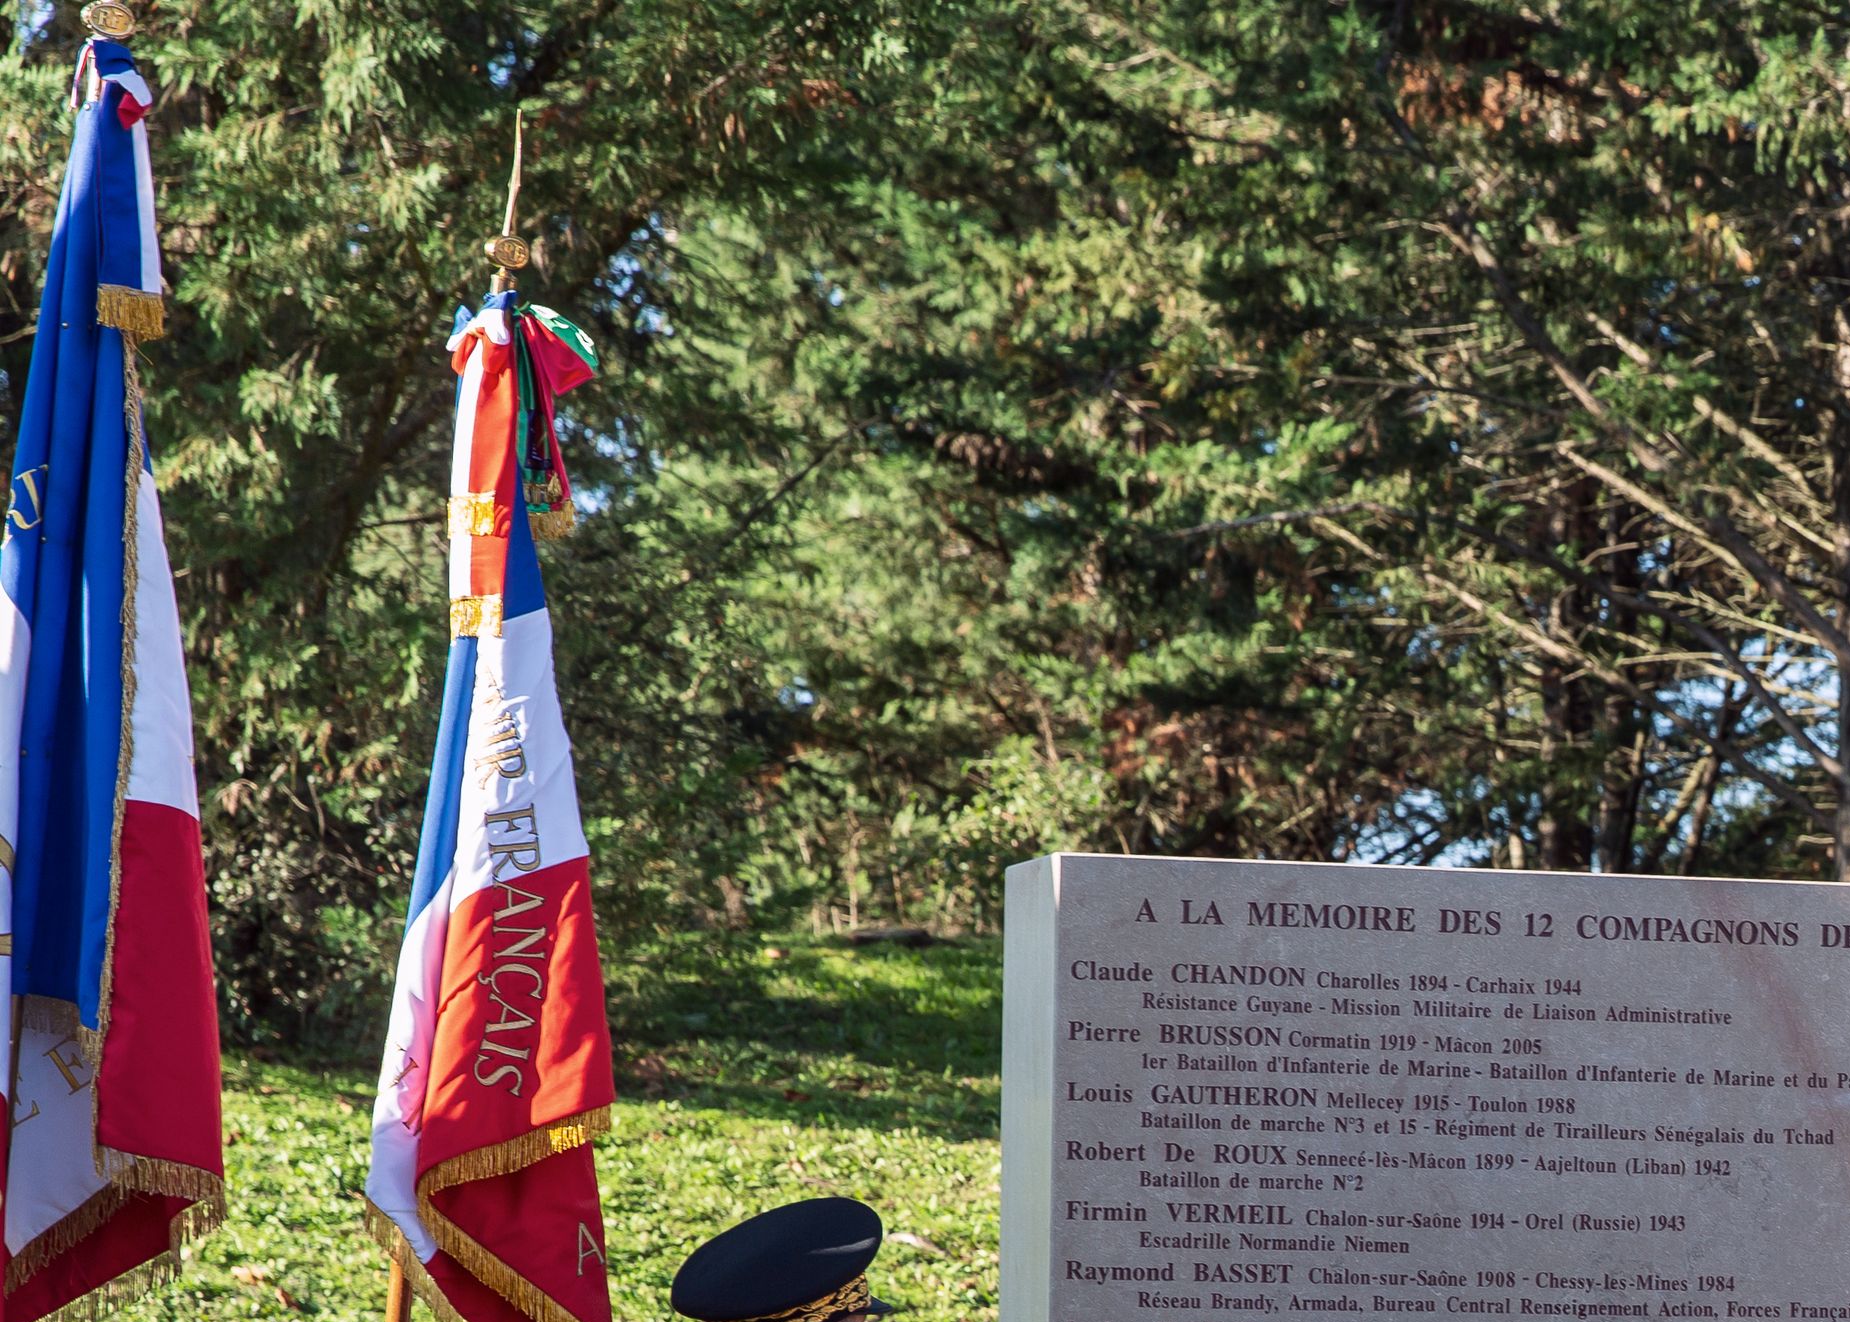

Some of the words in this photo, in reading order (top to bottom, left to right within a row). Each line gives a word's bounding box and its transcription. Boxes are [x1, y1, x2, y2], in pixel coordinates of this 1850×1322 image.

[1135, 898, 1158, 922] A
[1181, 900, 1224, 925] LA
[1247, 902, 1416, 932] MEMOIRE
[1438, 909, 1501, 935] DES
[1525, 913, 1553, 937] 12
[1577, 915, 1798, 946] COMPAGNONS
[474, 802, 546, 1097] FRANÇAIS
[1071, 960, 1153, 982] Claude
[1171, 964, 1305, 986] CHANDON
[1142, 992, 1237, 1011] Résistance
[1247, 995, 1312, 1016] Guyane
[1331, 998, 1400, 1016] Mission
[1413, 1000, 1491, 1018] Militaire
[1504, 1003, 1523, 1019] de
[1533, 1003, 1596, 1021] Liaison
[1605, 1006, 1732, 1024] Administrative
[1068, 1021, 1141, 1042] Pierre
[1159, 1024, 1282, 1046] BRUSSON
[1067, 1082, 1132, 1103] Louis
[1151, 1084, 1318, 1107] GAUTHERON
[1066, 1141, 1146, 1161] Robert
[1164, 1143, 1194, 1162] De
[1214, 1144, 1287, 1165] ROUX
[1066, 1201, 1147, 1221] Firmin
[1165, 1203, 1293, 1225] VERMEIL
[1066, 1261, 1174, 1285] Raymond
[1193, 1263, 1293, 1284] BASSET
